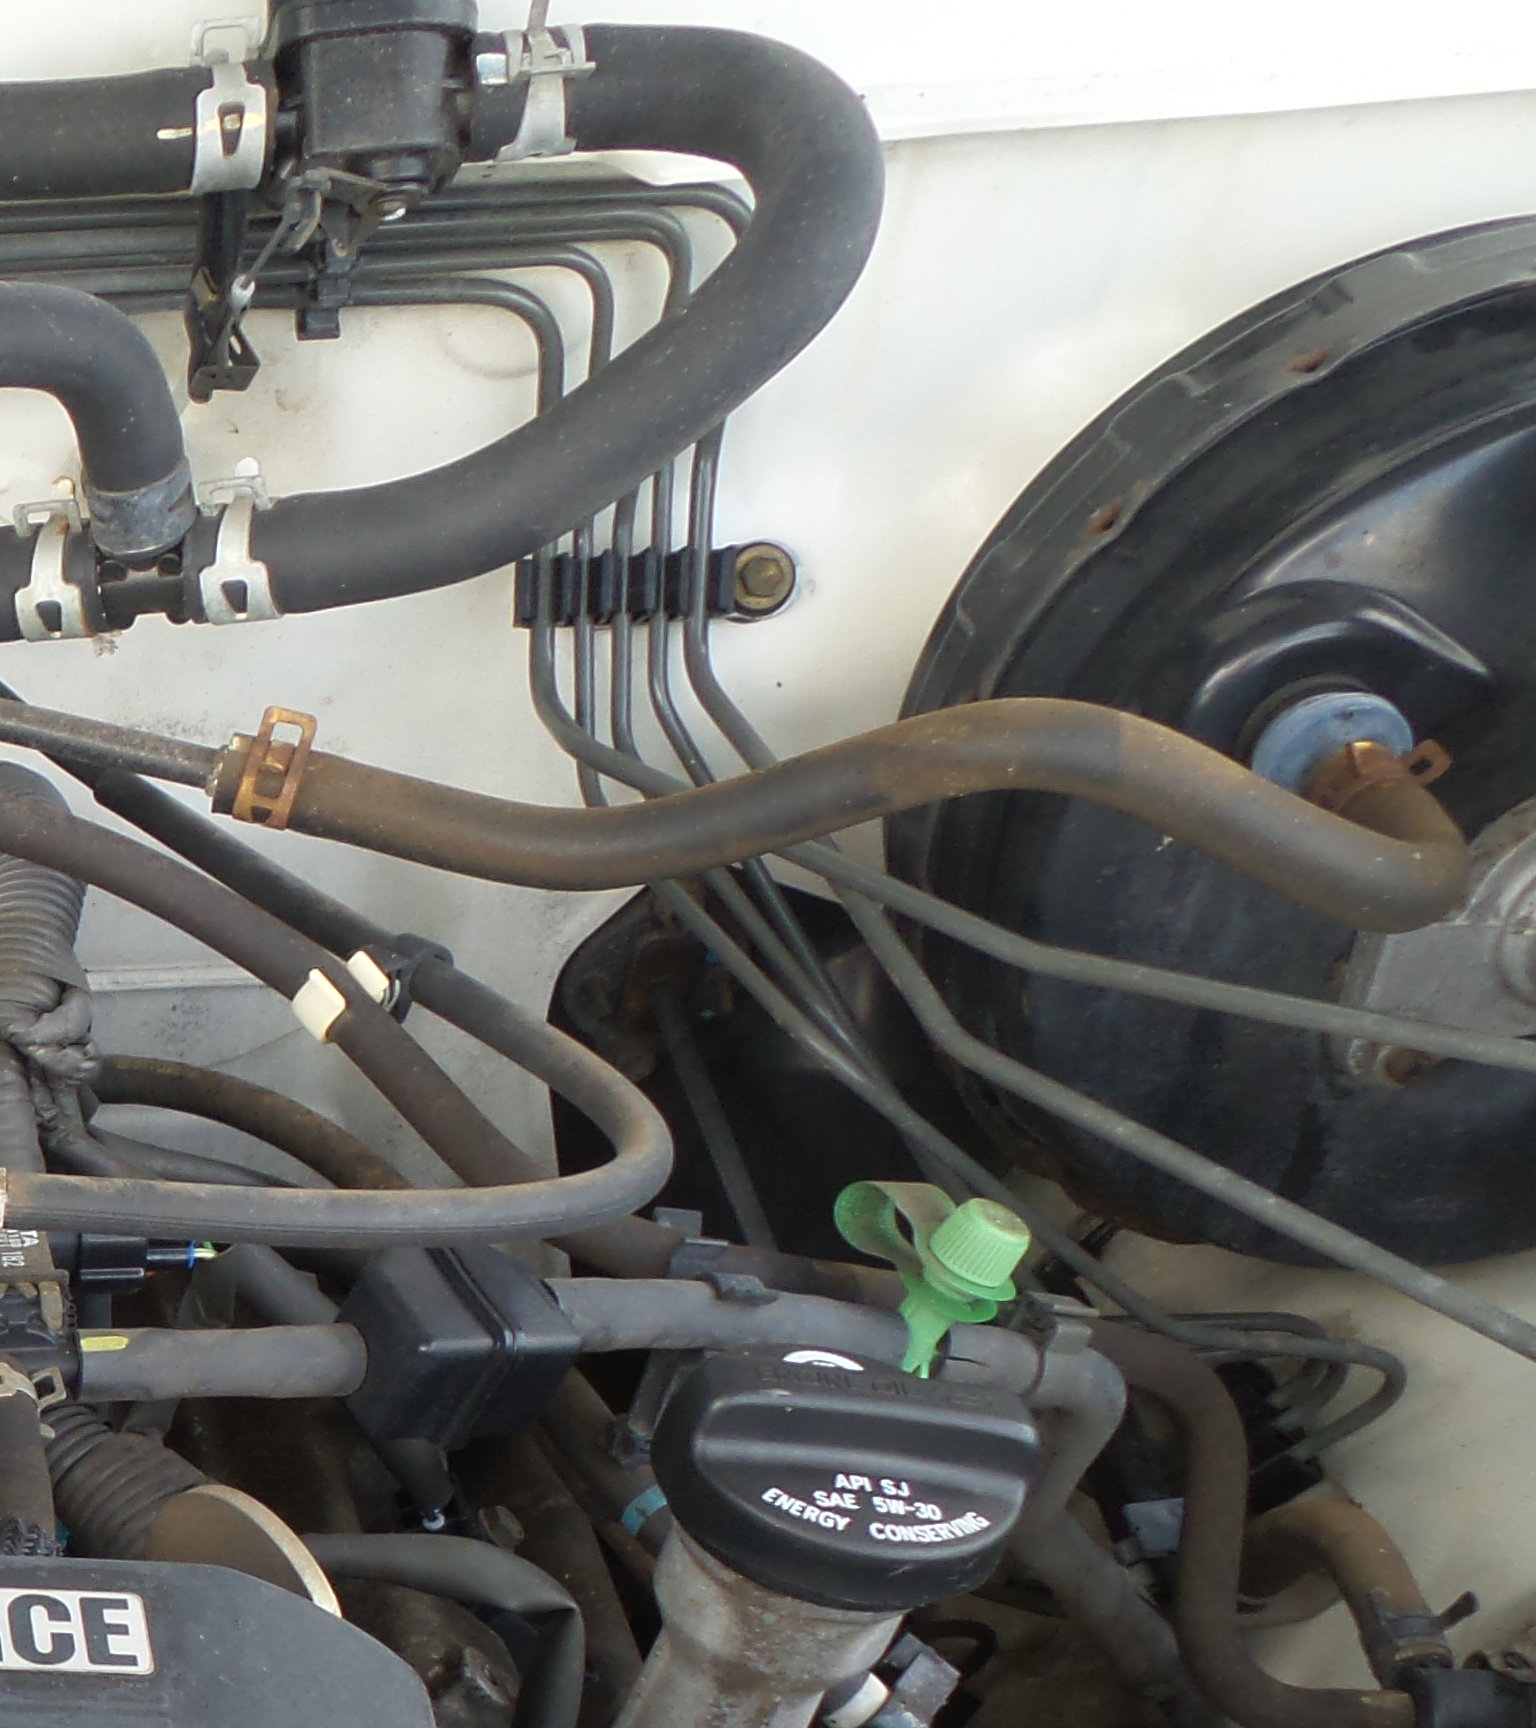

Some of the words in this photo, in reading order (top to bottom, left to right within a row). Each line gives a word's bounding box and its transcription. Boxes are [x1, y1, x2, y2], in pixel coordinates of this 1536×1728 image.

[834, 1473, 872, 1492] API
[880, 1478, 911, 1498] SJ
[761, 1486, 851, 1532] ENERGY
[869, 1510, 991, 1543] CONSERVING
[813, 1490, 861, 1510] SAE
[872, 1495, 943, 1522] 5W-30
